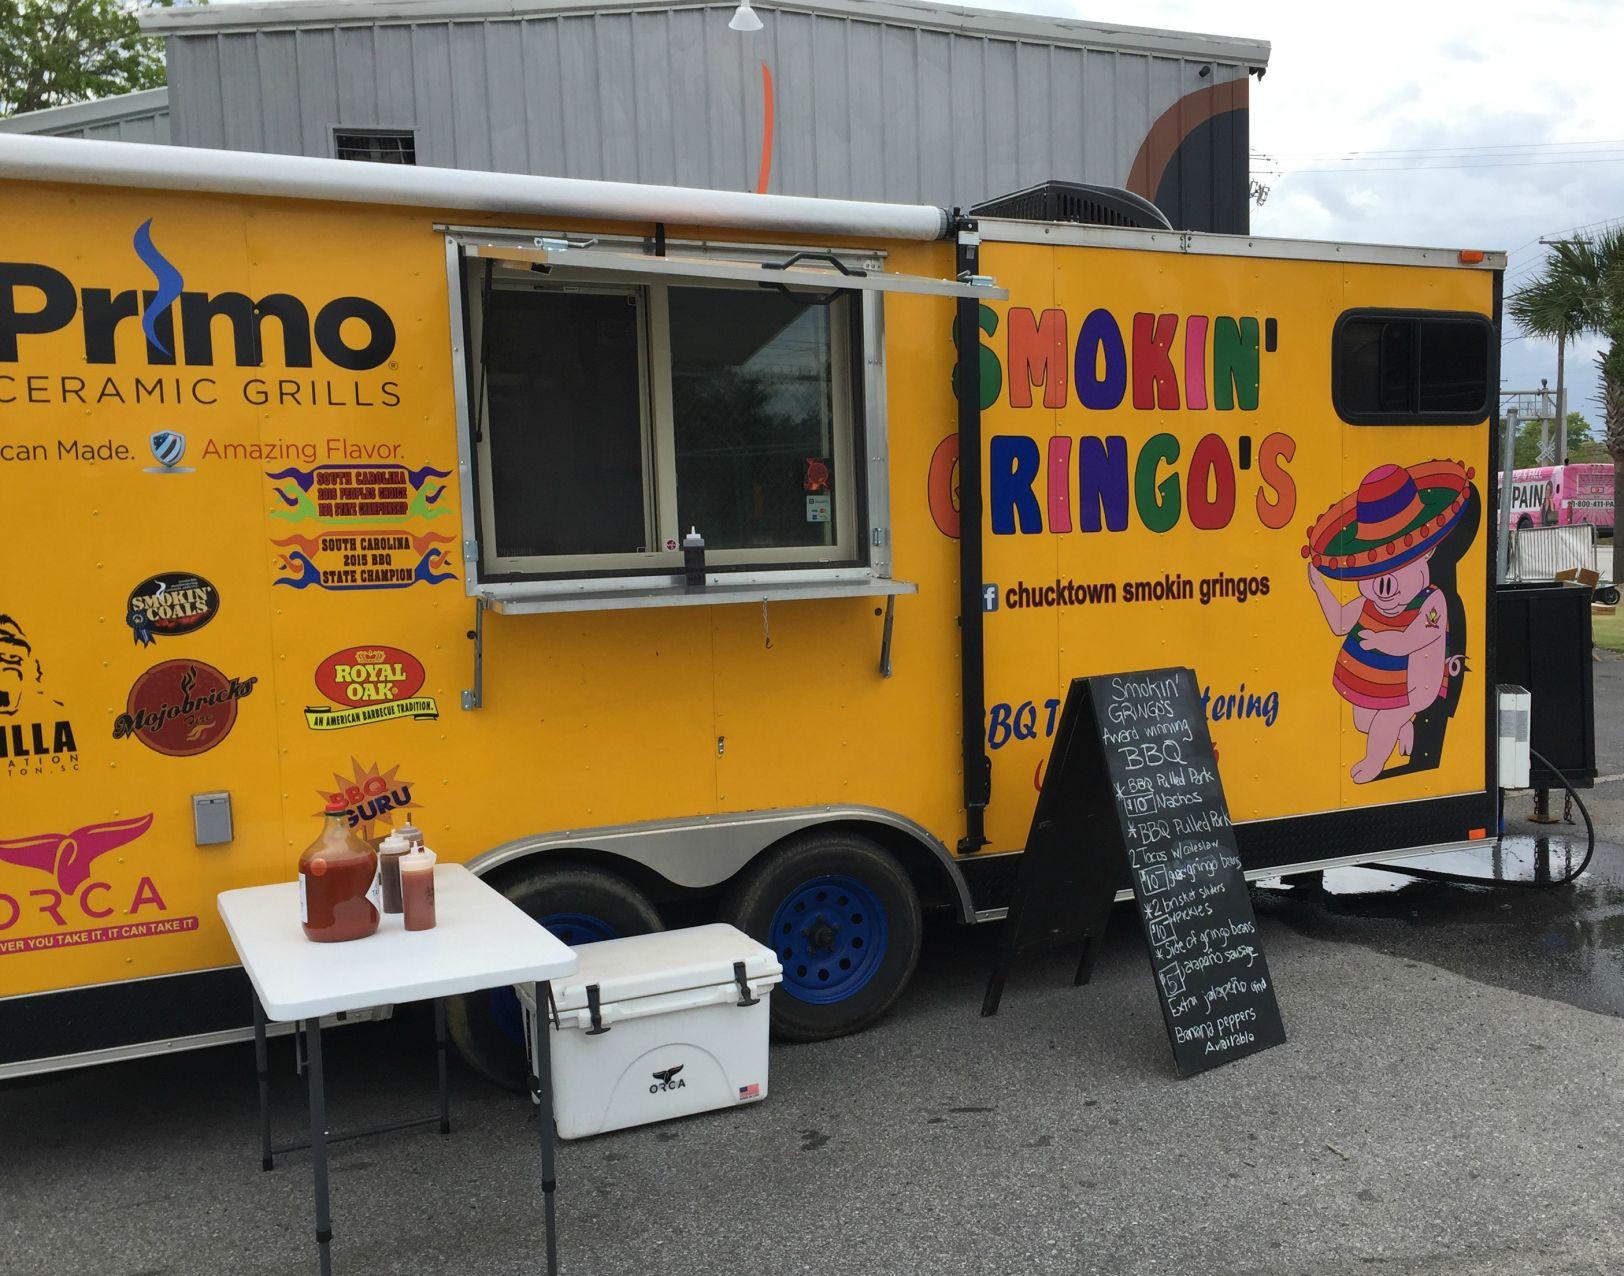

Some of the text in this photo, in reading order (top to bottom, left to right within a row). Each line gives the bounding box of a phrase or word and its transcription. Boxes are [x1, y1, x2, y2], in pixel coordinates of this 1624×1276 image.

[0, 262, 396, 371] Primo
[952, 303, 1277, 411] SMOKIN'
[0, 375, 400, 407] CERAMIC GRILLS
[57, 439, 135, 462] Made.
[202, 438, 318, 464] Amazing
[327, 438, 405, 462] Flavor.
[316, 471, 407, 486] SOUTH CAROLINA
[928, 432, 1297, 539] GRINGO'S
[1512, 484, 1544, 509] PAIN
[322, 536, 411, 552] SOUTH CAROLINA
[343, 553, 392, 567] 2015 BBQ
[322, 568, 413, 584] STATE CHAMPION
[132, 586, 212, 611] SMOKIN'
[1005, 578, 1117, 609] chucktown
[1122, 573, 1194, 602] smokin
[1199, 572, 1270, 605] gringos
[146, 600, 208, 621] COALS
[335, 663, 406, 683] ROYAL
[346, 683, 394, 700] OAK
[112, 676, 258, 739] Mojobricks
[313, 716, 324, 727] AN
[326, 712, 361, 726] AMERICAN
[362, 705, 395, 721] BARBECUE
[988, 701, 1037, 750] BQ
[1201, 683, 1279, 728] tering
[1102, 719, 1193, 745] Award winning
[8, 754, 79, 768] ATION
[1118, 740, 1187, 770] BBQ
[329, 776, 389, 805] BBQ
[1128, 777, 1154, 793] BBQ
[1156, 767, 1185, 788] Pulled
[345, 785, 412, 828] GURU
[1156, 792, 1202, 809] Nachos
[1138, 820, 1171, 844] BBQ
[1173, 812, 1211, 835] Pulled
[1129, 849, 1140, 868] 2
[1136, 847, 1167, 863] Tacos
[1187, 858, 1218, 883] gringo
[28, 936, 53, 949] YOU
[57, 932, 88, 945] TAKE
[109, 928, 119, 938] IT
[121, 925, 147, 937] CAN
[150, 921, 180, 933] TAKE
[183, 919, 193, 928] IT
[1186, 930, 1197, 948] of
[1200, 926, 1229, 952] gringo
[1228, 919, 1255, 937] beans
[1168, 997, 1198, 1017] Extra
[1175, 1008, 1256, 1043] Banana peppers
[1205, 1033, 1254, 1055] Available
[649, 1079, 686, 1094] ORCA
